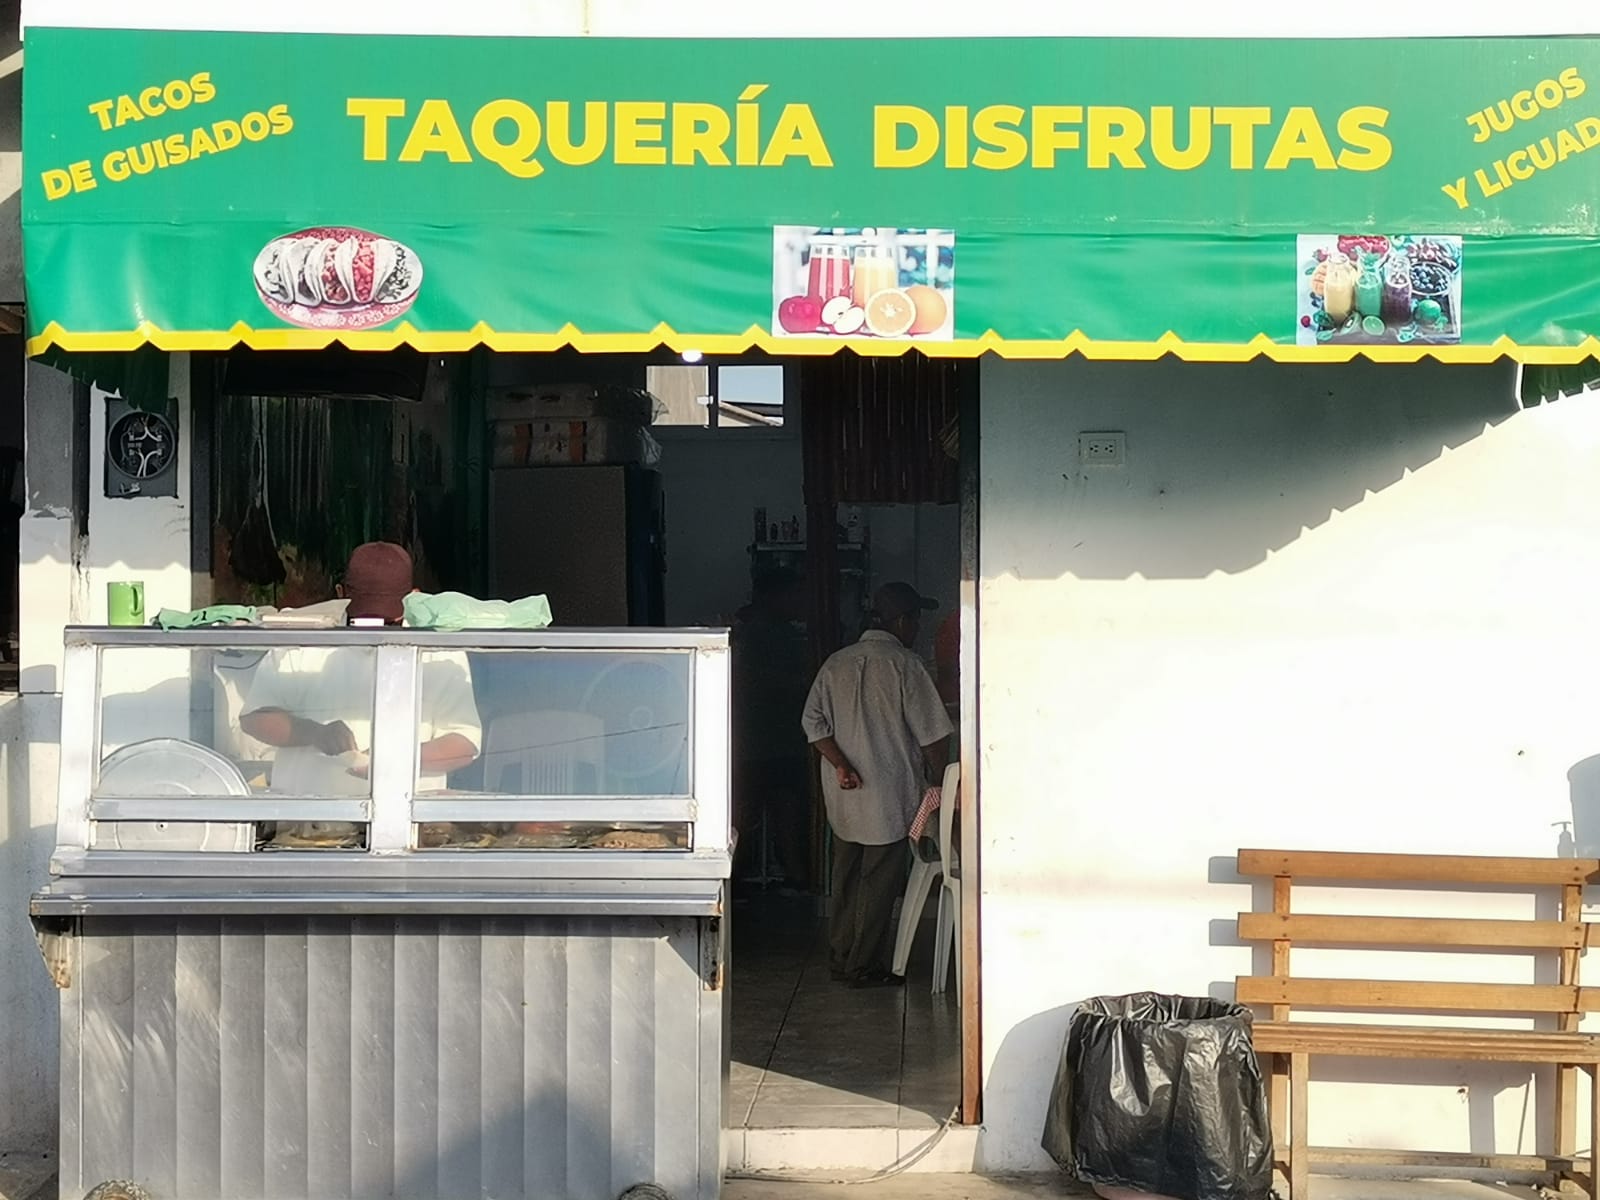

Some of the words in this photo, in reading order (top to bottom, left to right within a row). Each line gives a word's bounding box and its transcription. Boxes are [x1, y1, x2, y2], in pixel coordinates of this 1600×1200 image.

[88, 71, 216, 131] TACOS
[346, 84, 834, 179] TAQUERÍA
[873, 104, 1393, 172] DISFRUTAS
[1465, 66, 1587, 144] JUGOS
[41, 159, 97, 201] DE
[102, 104, 294, 182] GUISADOS
[1440, 176, 1470, 210] Y
